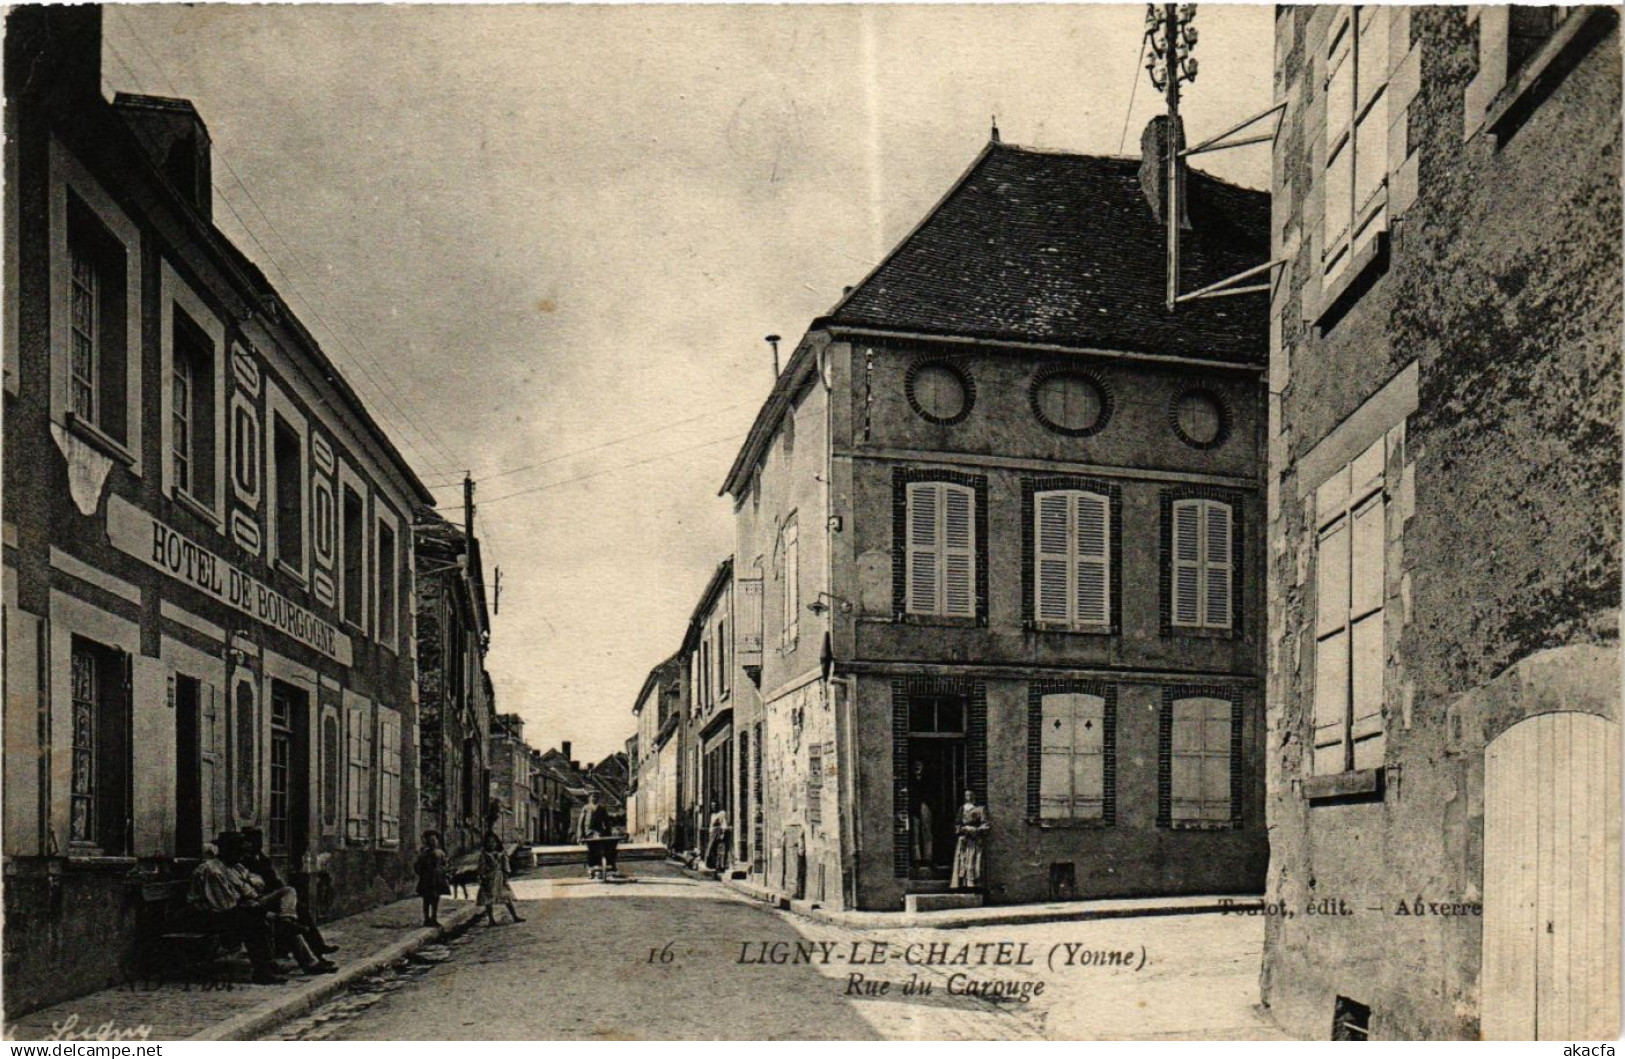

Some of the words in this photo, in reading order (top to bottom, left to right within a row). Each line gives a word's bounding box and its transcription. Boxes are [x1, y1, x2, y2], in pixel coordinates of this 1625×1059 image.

[152, 521, 222, 596] HOTEL
[228, 567, 252, 611] DE
[257, 583, 336, 657] BOURGOGNE
